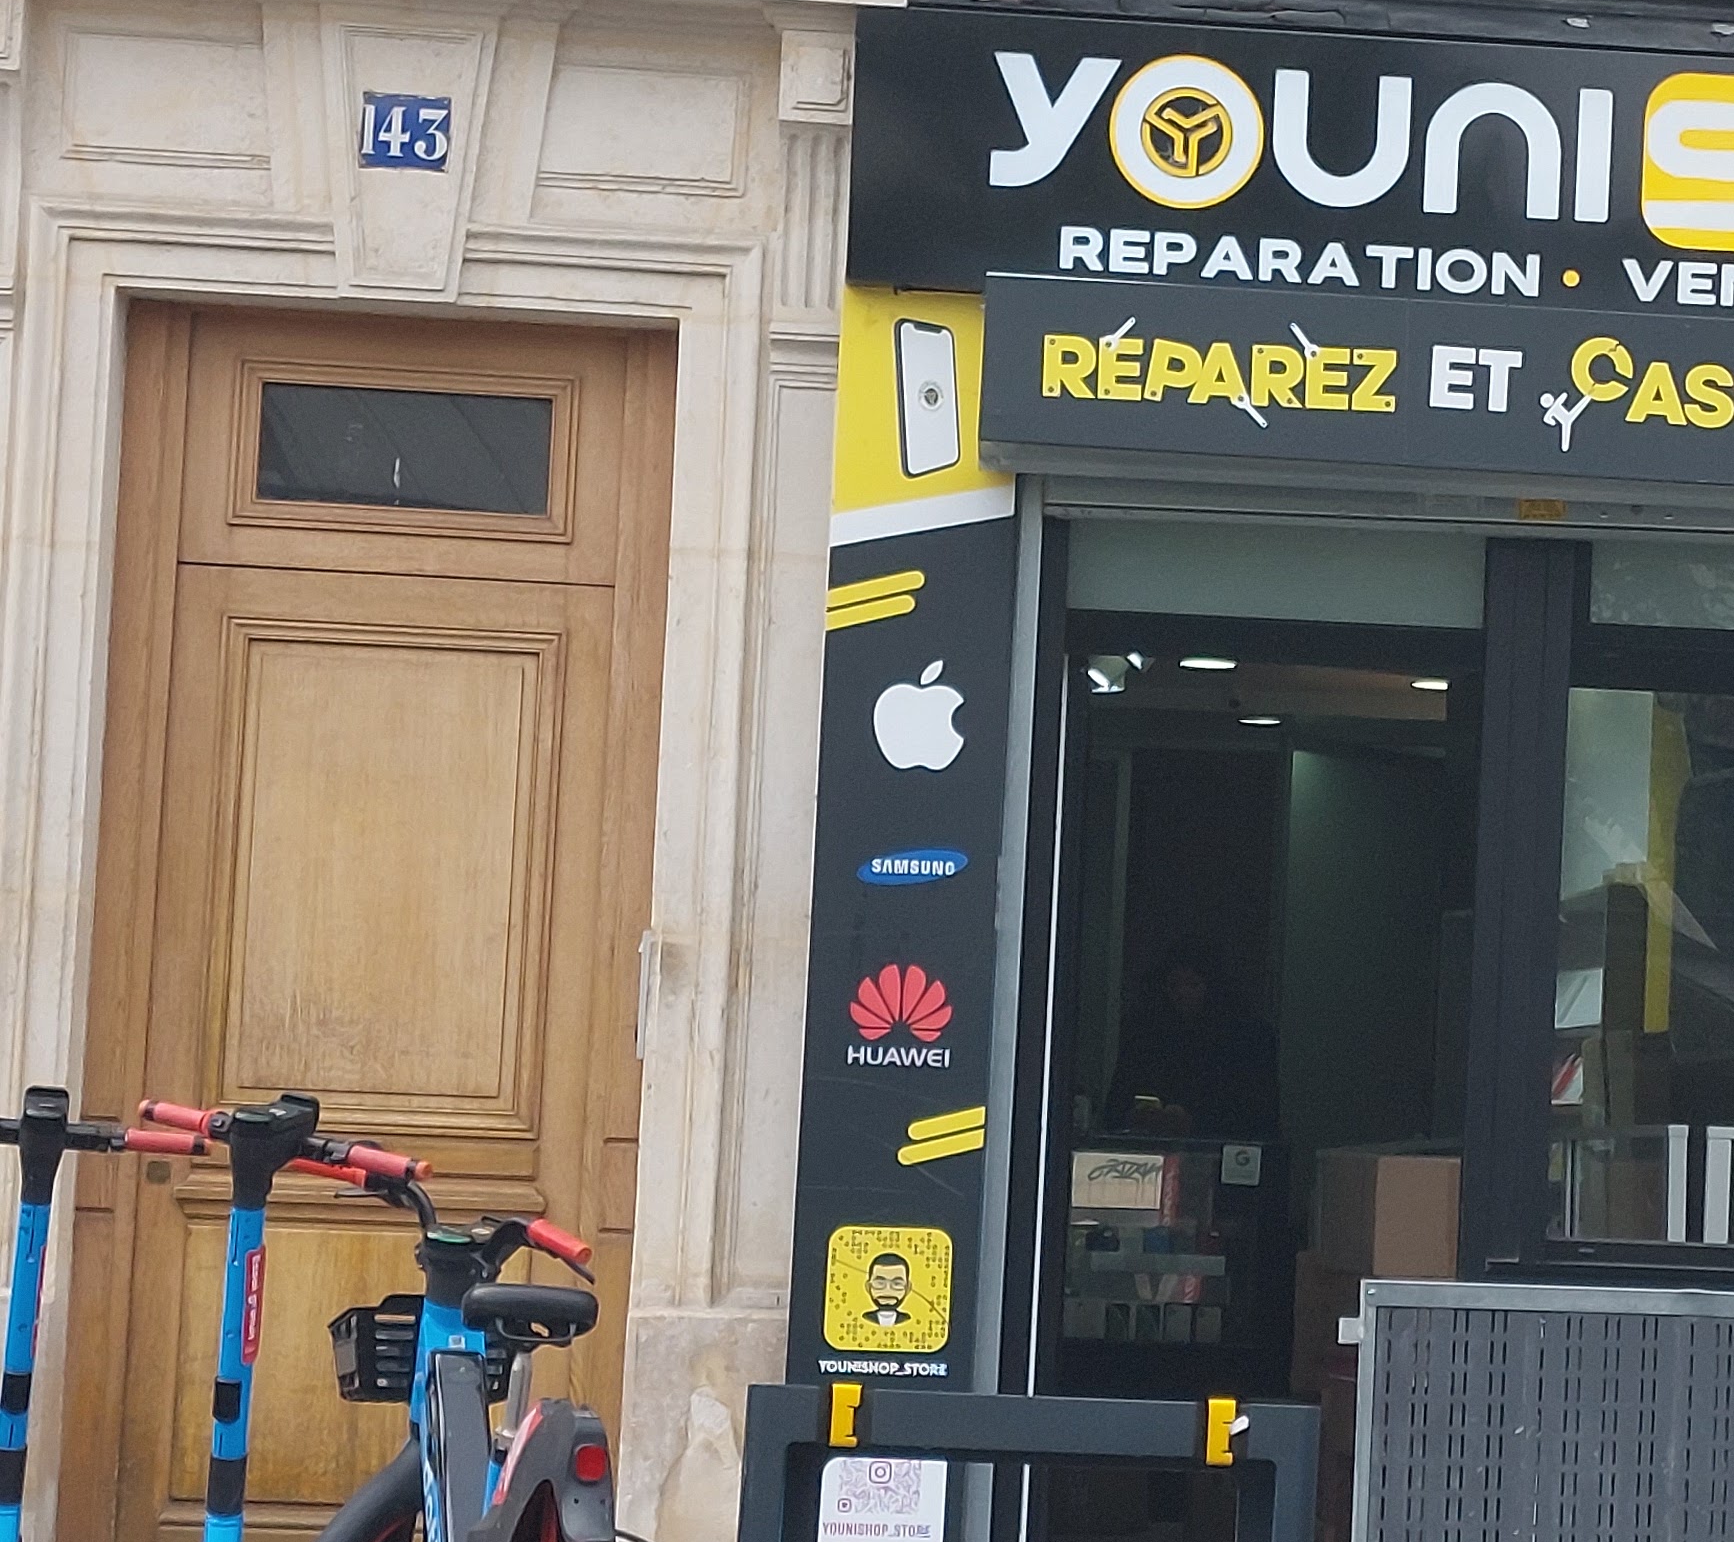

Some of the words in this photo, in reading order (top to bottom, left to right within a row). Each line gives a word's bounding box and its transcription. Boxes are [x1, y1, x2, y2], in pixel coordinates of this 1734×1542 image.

[361, 104, 448, 161] 143
[1059, 226, 1541, 297] REPARATION
[1429, 344, 1523, 413] ET
[870, 858, 956, 877] SAMSUNG
[846, 1044, 950, 1068] HUAWEI
